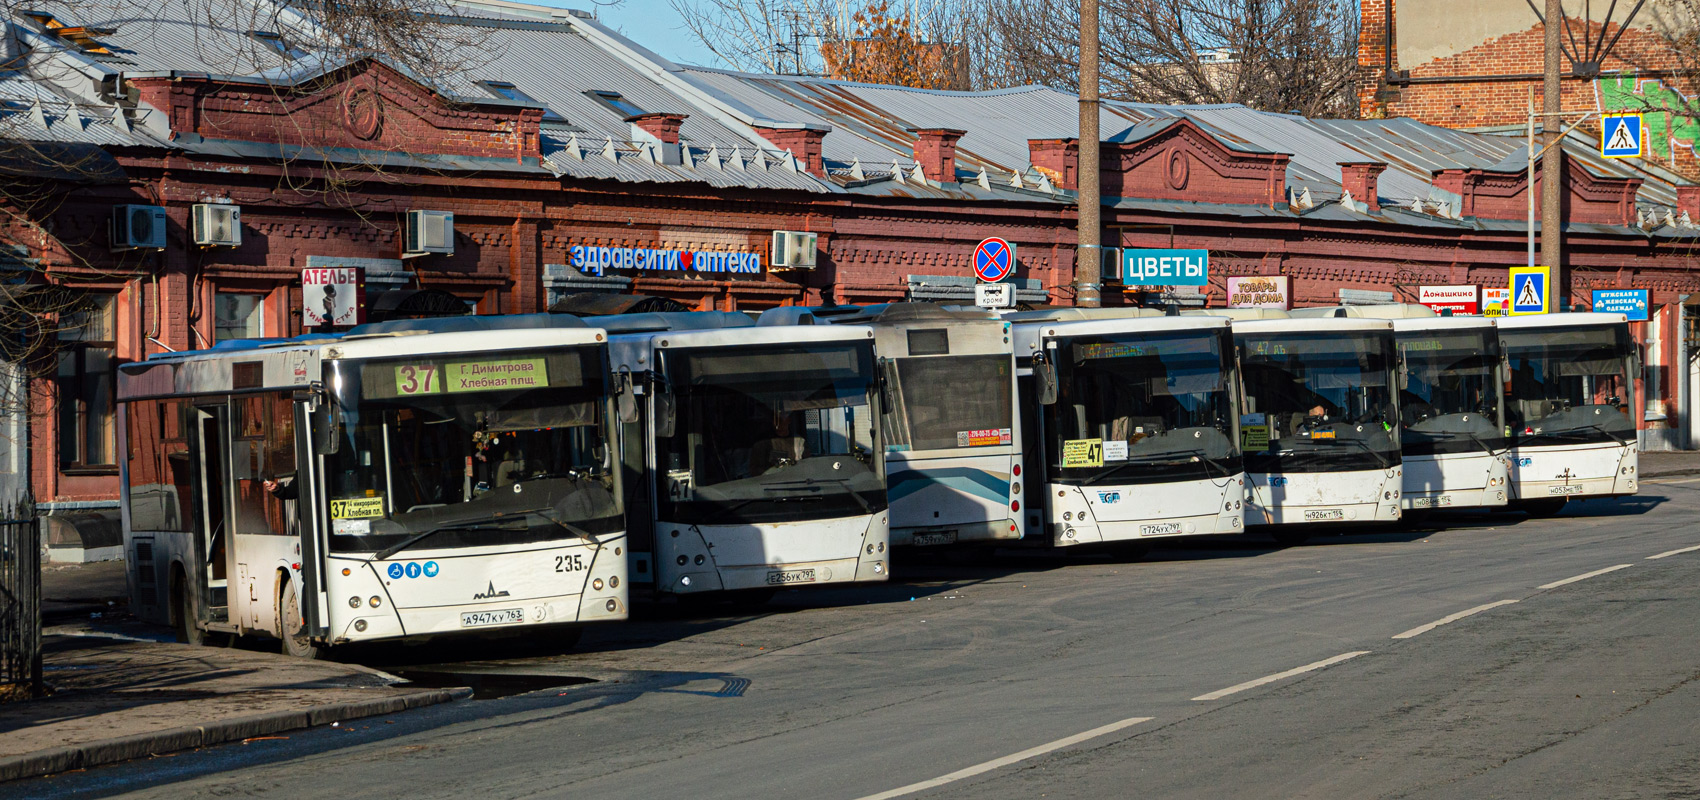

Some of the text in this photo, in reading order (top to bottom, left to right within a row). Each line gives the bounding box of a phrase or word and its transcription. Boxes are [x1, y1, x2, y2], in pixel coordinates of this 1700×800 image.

[571, 245, 760, 276] здравсити аптека
[1129, 256, 1203, 281] ЦВЕТЫ
[303, 269, 356, 285] АТЕЛЬЕ
[1238, 282, 1278, 293] ТОВАРЫ
[1423, 290, 1473, 298] Домашкино
[1231, 293, 1284, 305] ДЛЯ ДОМА
[305, 306, 355, 325] ХИМСТКА
[460, 362, 534, 375] Г. Димитрова
[400, 365, 436, 393] 37
[460, 377, 537, 388] Хлебная плщ.
[1088, 444, 1102, 463] 47
[670, 480, 690, 498] 47
[332, 501, 347, 517] 37
[353, 499, 382, 507] микрорайон
[347, 508, 372, 516] Хлебная
